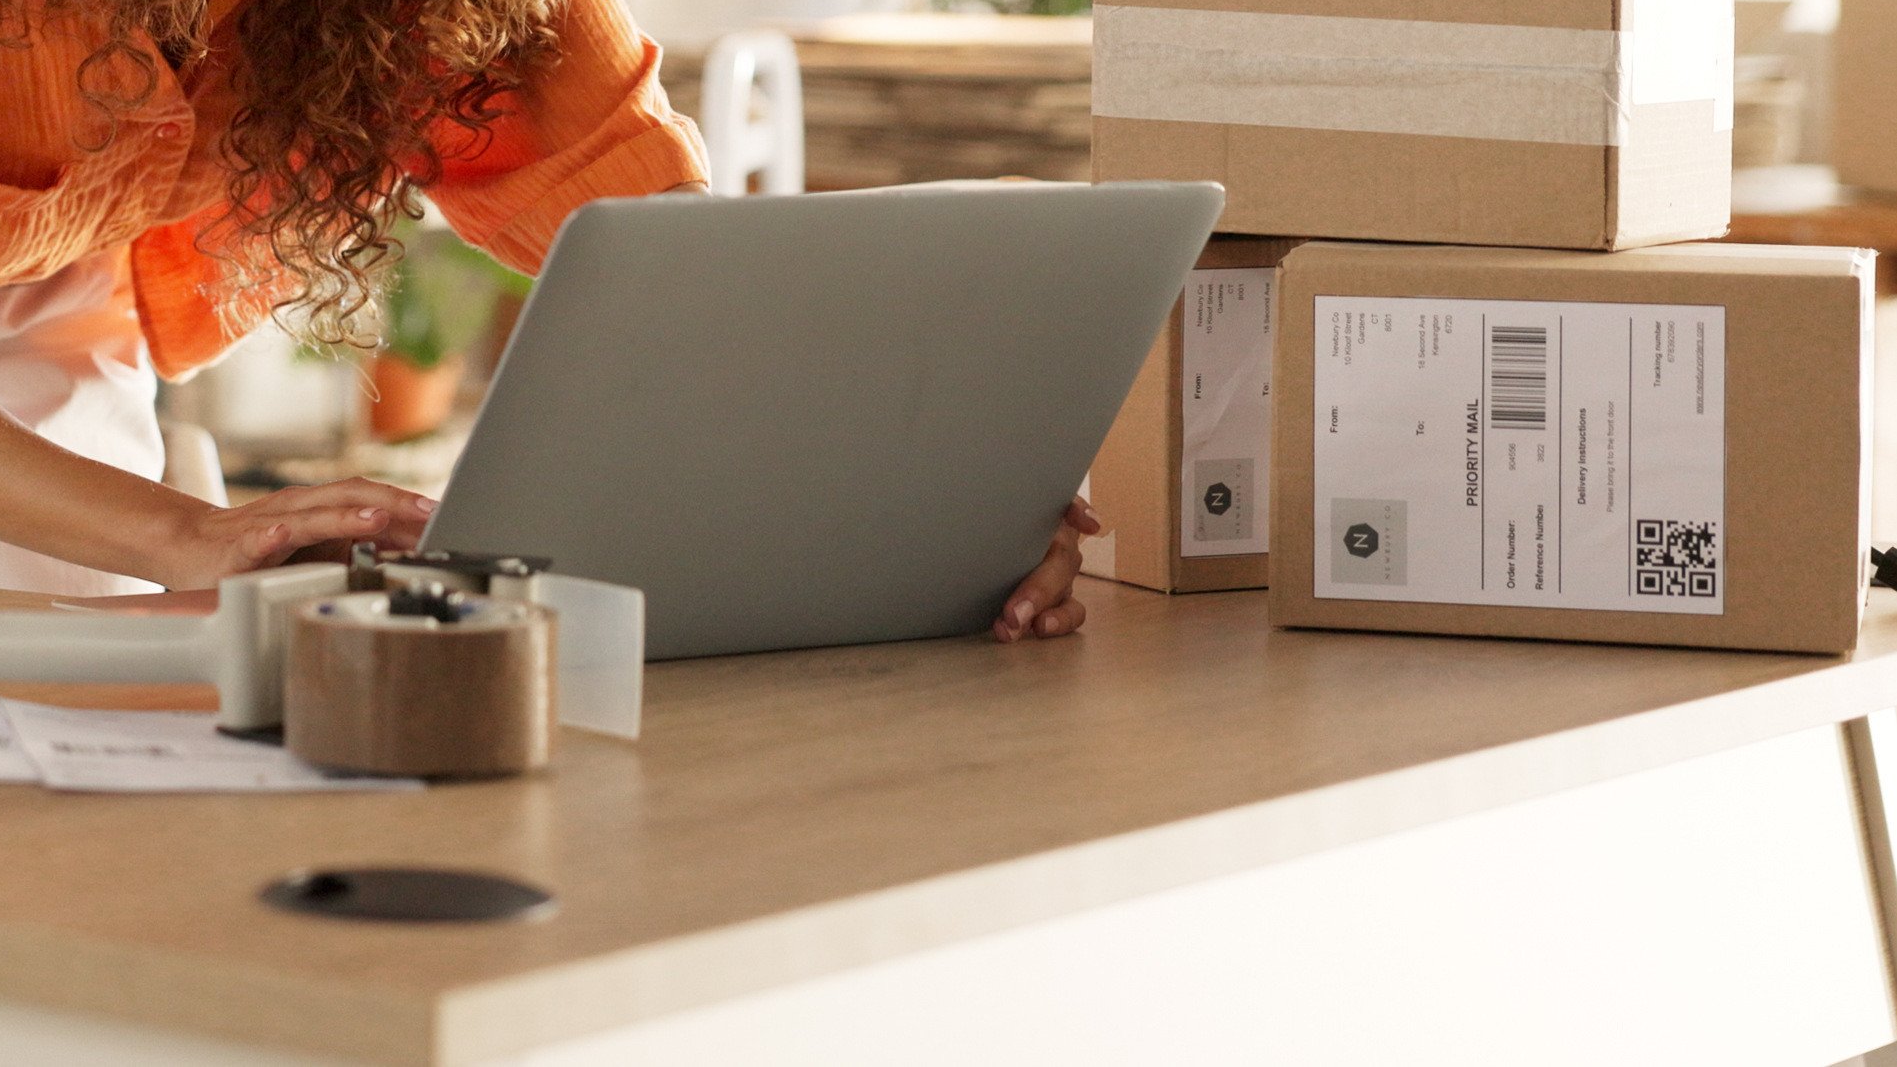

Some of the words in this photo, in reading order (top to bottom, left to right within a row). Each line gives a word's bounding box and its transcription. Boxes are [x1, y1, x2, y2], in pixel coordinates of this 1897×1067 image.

[1228, 284, 1234, 294] CT
[1330, 311, 1339, 323] Co
[1344, 312, 1352, 335] Street
[1371, 313, 1379, 324] CT
[1207, 326, 1213, 334] 10
[1332, 325, 1341, 357] Newbury
[1432, 314, 1440, 356] Kensington
[1418, 330, 1426, 358] Second
[1344, 356, 1352, 366] 10
[1653, 353, 1662, 387] Tracking
[1194, 373, 1202, 399] From:
[1262, 382, 1270, 396] To:
[1329, 405, 1339, 433] From:
[1466, 398, 1479, 434] MAIL
[1606, 400, 1614, 418] door
[1416, 420, 1425, 435] To:
[1577, 408, 1586, 464] Instructions
[1606, 419, 1614, 437] front
[1606, 438, 1614, 450] the
[1466, 438, 1479, 507] PRIORITY
[1606, 467, 1615, 486] bring
[1577, 467, 1587, 505] Delivery
[1211, 492, 1224, 506] N
[1606, 487, 1614, 513] Please
[1384, 505, 1391, 519] CO
[1353, 534, 1368, 548] N
[1507, 520, 1516, 560] Number:
[1507, 563, 1516, 589] Order
[1535, 543, 1544, 590] Reference
